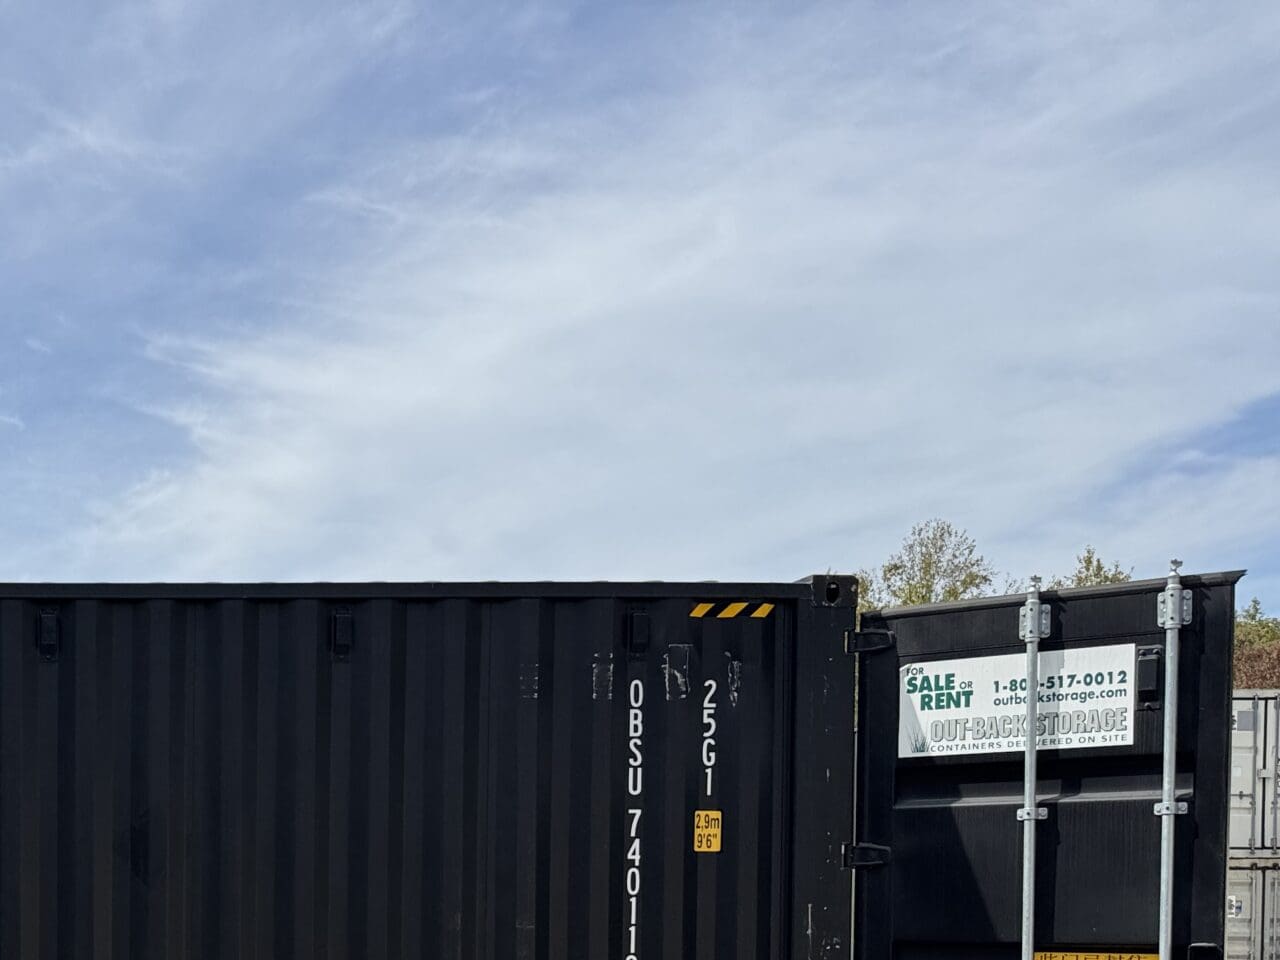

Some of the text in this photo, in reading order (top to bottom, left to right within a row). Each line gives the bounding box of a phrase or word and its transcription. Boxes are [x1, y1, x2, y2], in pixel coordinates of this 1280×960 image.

[906, 667, 924, 676] FOR
[993, 670, 1128, 693] 1-80-517-0012
[906, 673, 973, 694] SALE OR
[920, 690, 974, 711] RENT
[993, 688, 1128, 706] outbkstorage.com
[930, 707, 1128, 743] OUT-BACK STORAGE
[628, 679, 644, 796] OBSU
[702, 679, 718, 796] 25G1
[930, 733, 1128, 753] CONTAINERS DEERED ON SITE
[696, 833, 718, 849] 9'6"
